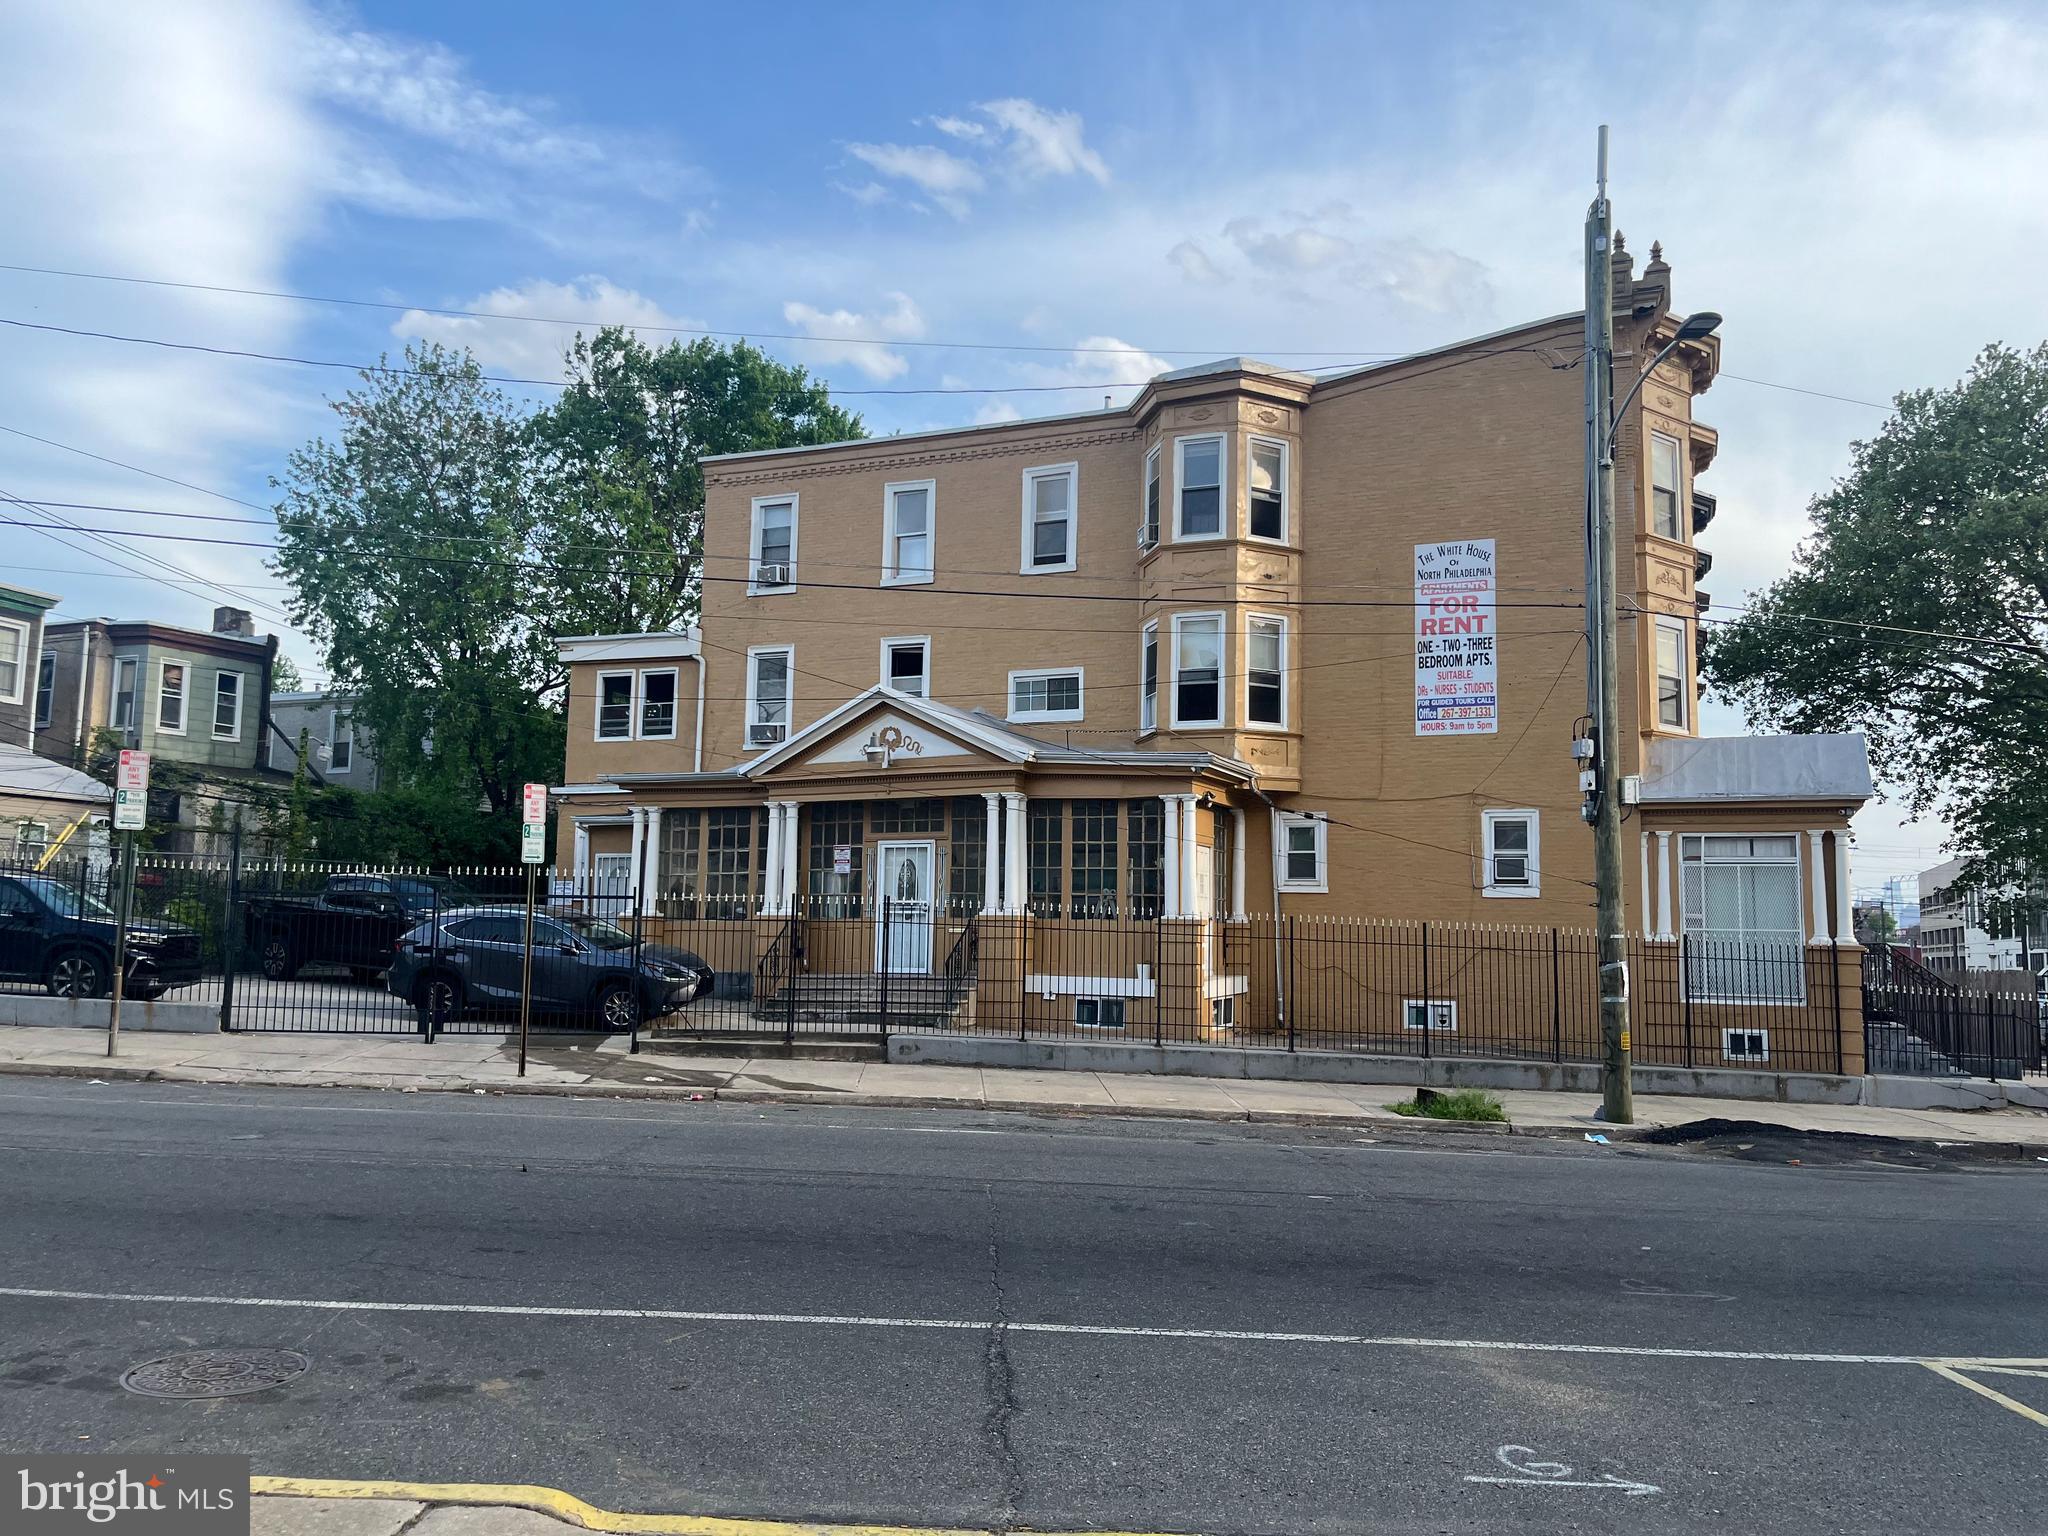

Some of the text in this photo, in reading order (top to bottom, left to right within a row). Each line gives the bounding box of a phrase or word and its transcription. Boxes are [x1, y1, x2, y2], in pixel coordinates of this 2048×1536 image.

[1418, 544, 1491, 566] THE WHITE HOUSE
[1418, 568, 1492, 580] NORTH PHILADELPHIA
[1422, 581, 1487, 595] APARTMENTS
[1430, 595, 1479, 615] FOR
[1421, 615, 1488, 636] RENT
[1417, 641, 1433, 653] ONE
[1442, 639, 1460, 652] TWO
[1418, 653, 1492, 669] BEDROOM APTS.
[1437, 670, 1473, 680] SUITABLE:
[1435, 684, 1457, 695] NURSES
[1463, 682, 1494, 694] STUDENTS
[1419, 707, 1491, 719] Office 267-397-1331
[1421, 721, 1492, 731] HOURS: 9am to 5pm
[119, 792, 125, 803] 2
[525, 826, 529, 836] 2
